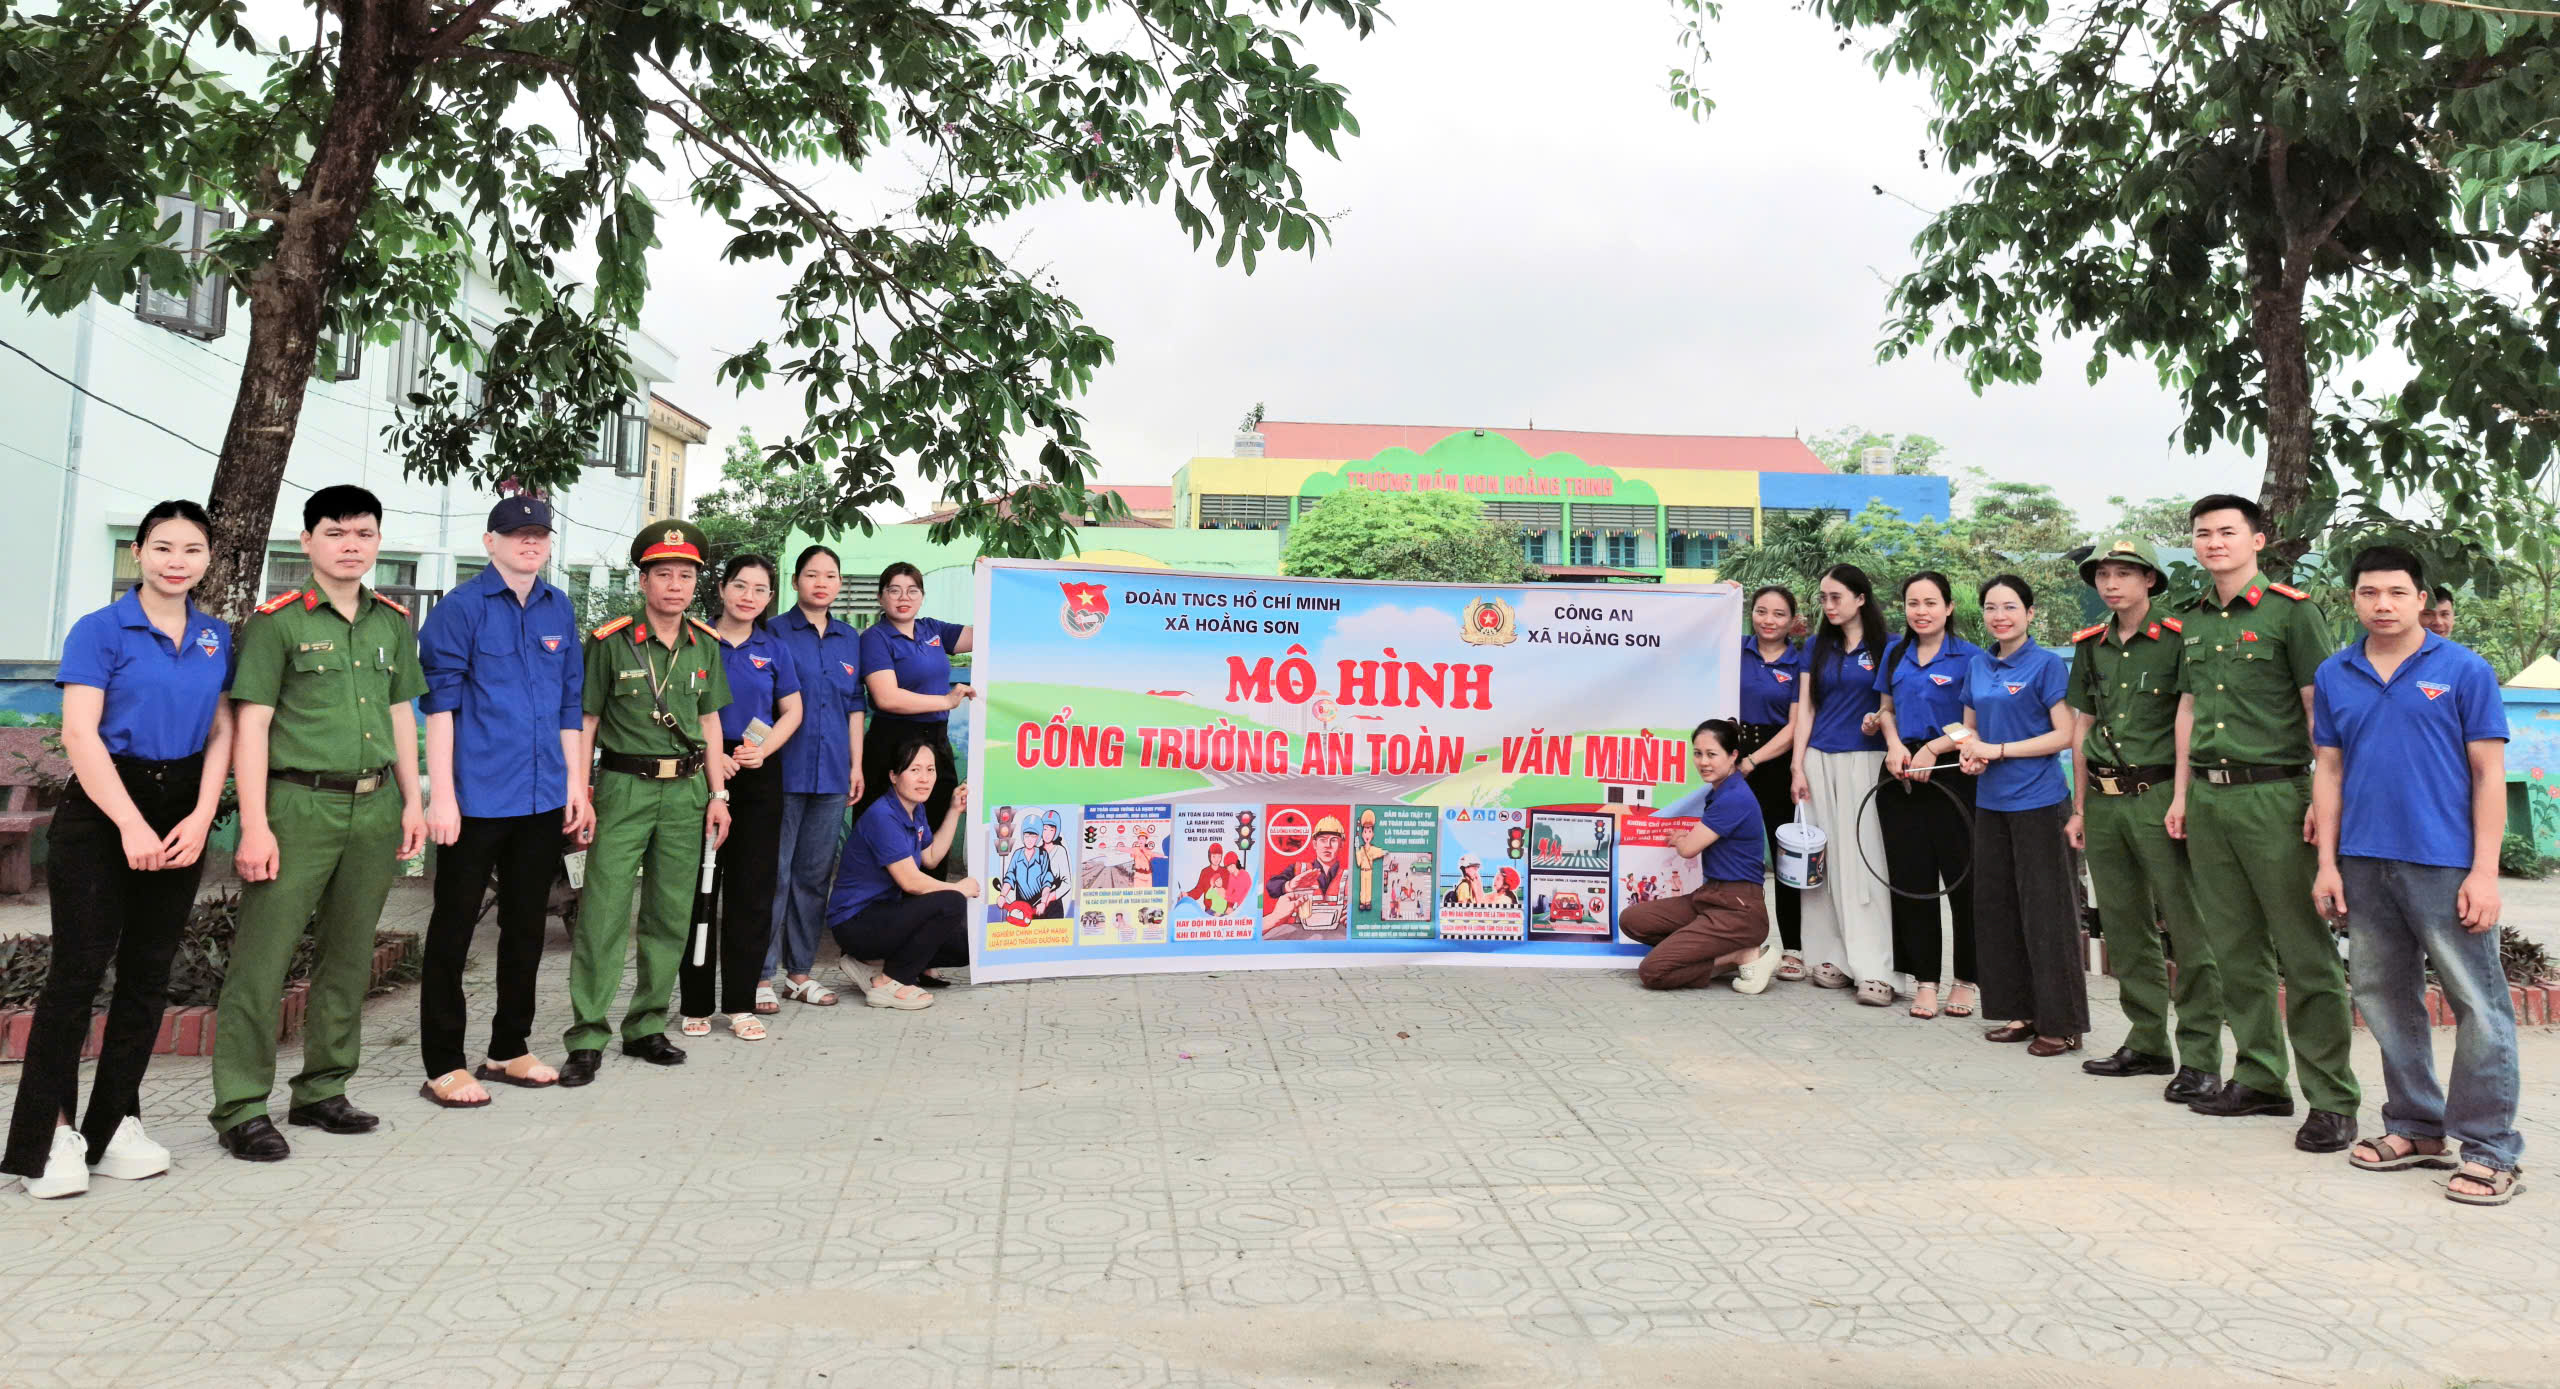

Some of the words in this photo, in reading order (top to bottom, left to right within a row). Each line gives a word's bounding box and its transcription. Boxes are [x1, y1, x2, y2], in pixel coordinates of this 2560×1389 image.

[1347, 467, 1412, 492] TRƯỜNG
[1464, 475, 1499, 494] NON
[1565, 477, 1613, 496] TRINH
[1125, 589, 1176, 606] ĐOÀN
[1182, 593, 1227, 608] TNCS
[1233, 590, 1257, 608] HỒ
[1263, 593, 1290, 609] CHÍ
[1296, 597, 1340, 611] MINH
[1165, 615, 1189, 631] XÃ
[1196, 612, 1257, 633] HOẰNG
[1263, 620, 1299, 634] SƠN
[1555, 604, 1603, 621] CÔNG
[1609, 609, 1633, 622] AN
[1528, 627, 1552, 643] XÃ
[1558, 626, 1619, 646] HOẰNG
[1625, 633, 1660, 647] SƠN
[1225, 643, 1317, 704] MÔ
[1336, 647, 1494, 710] HÌNH
[1016, 706, 1126, 769] CỔNG
[1137, 717, 1290, 775] TRƯỜNG
[1300, 730, 1354, 776] AN
[1366, 725, 1464, 776] TOÀN
[1475, 754, 1488, 762] -
[1501, 727, 1573, 776] VĂN
[1584, 734, 1687, 784] MINH
